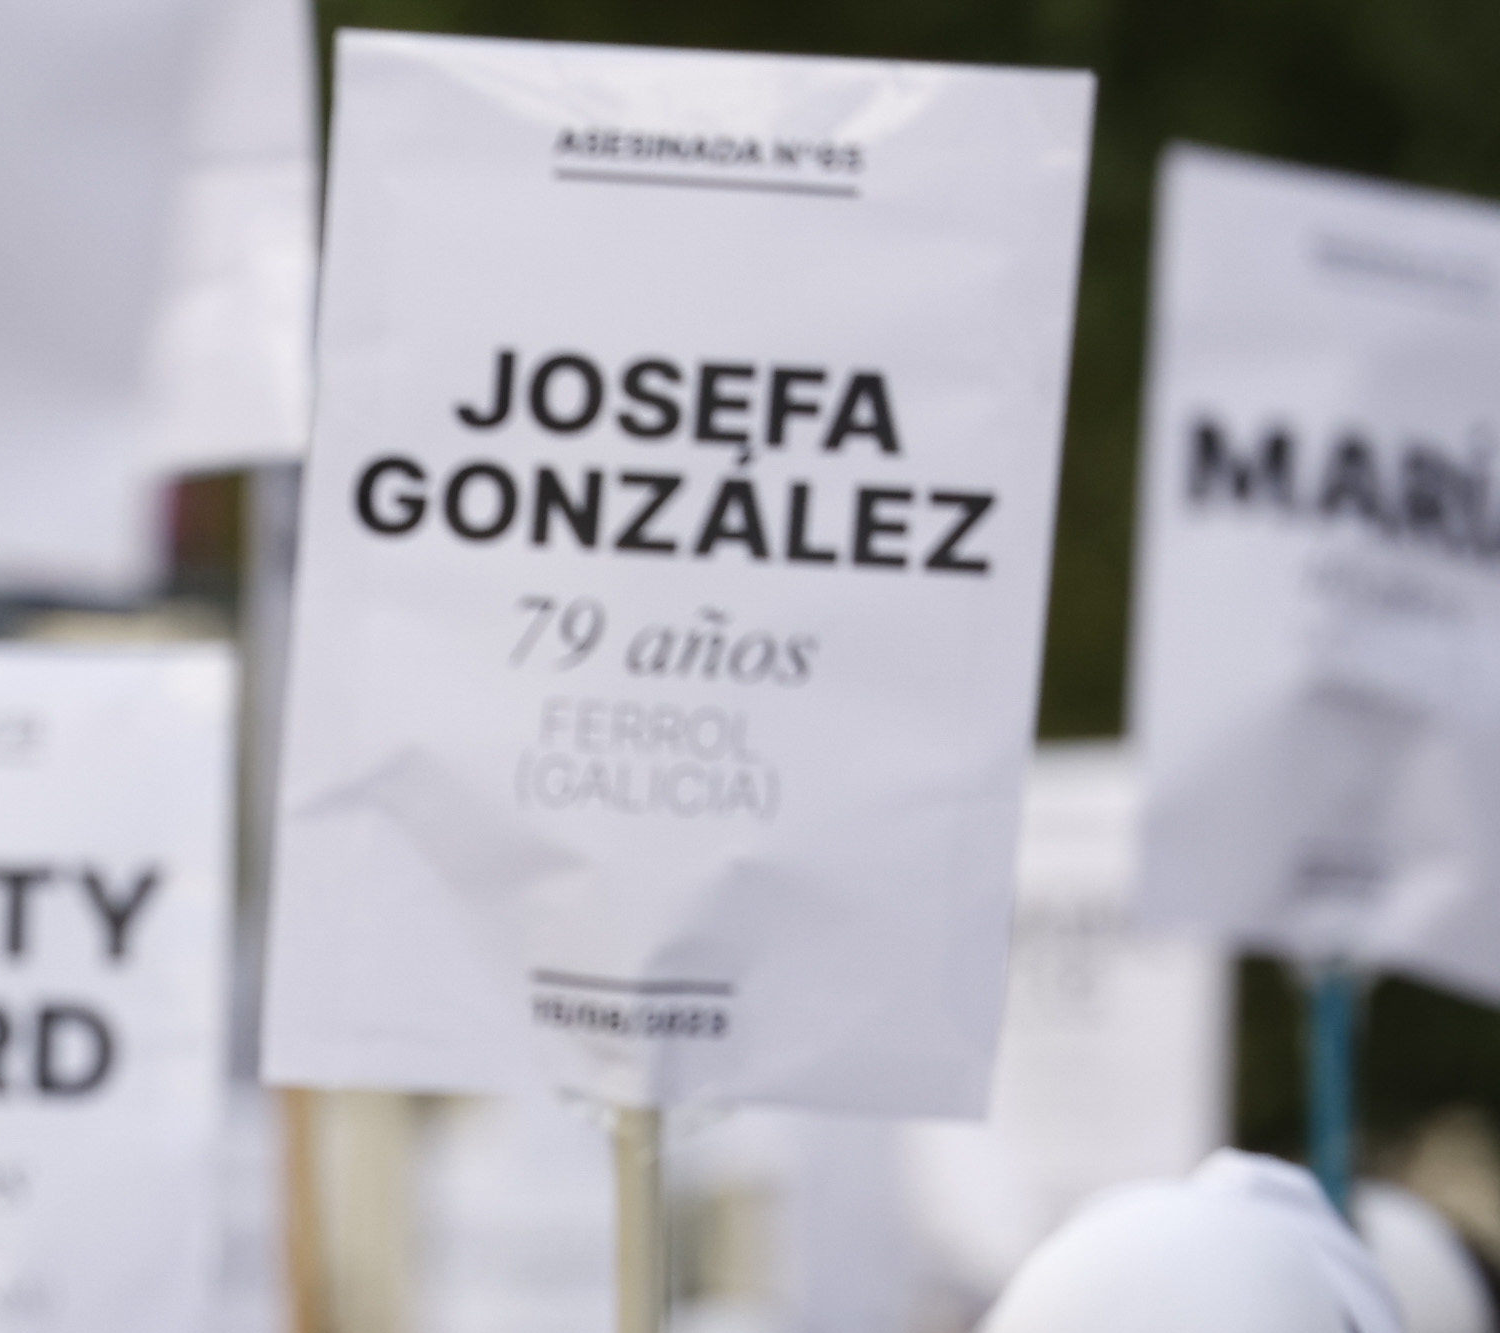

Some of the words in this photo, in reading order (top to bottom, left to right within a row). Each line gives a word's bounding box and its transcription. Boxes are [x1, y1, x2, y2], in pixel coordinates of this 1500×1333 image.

[554, 126, 764, 167] ASESINADA
[454, 347, 904, 455] JOSEFA
[353, 447, 999, 577] GONZÁLEZ
[508, 594, 607, 673] 79
[624, 604, 822, 688] años
[540, 699, 755, 766] FERROL
[514, 748, 781, 826] (GALICIA)
